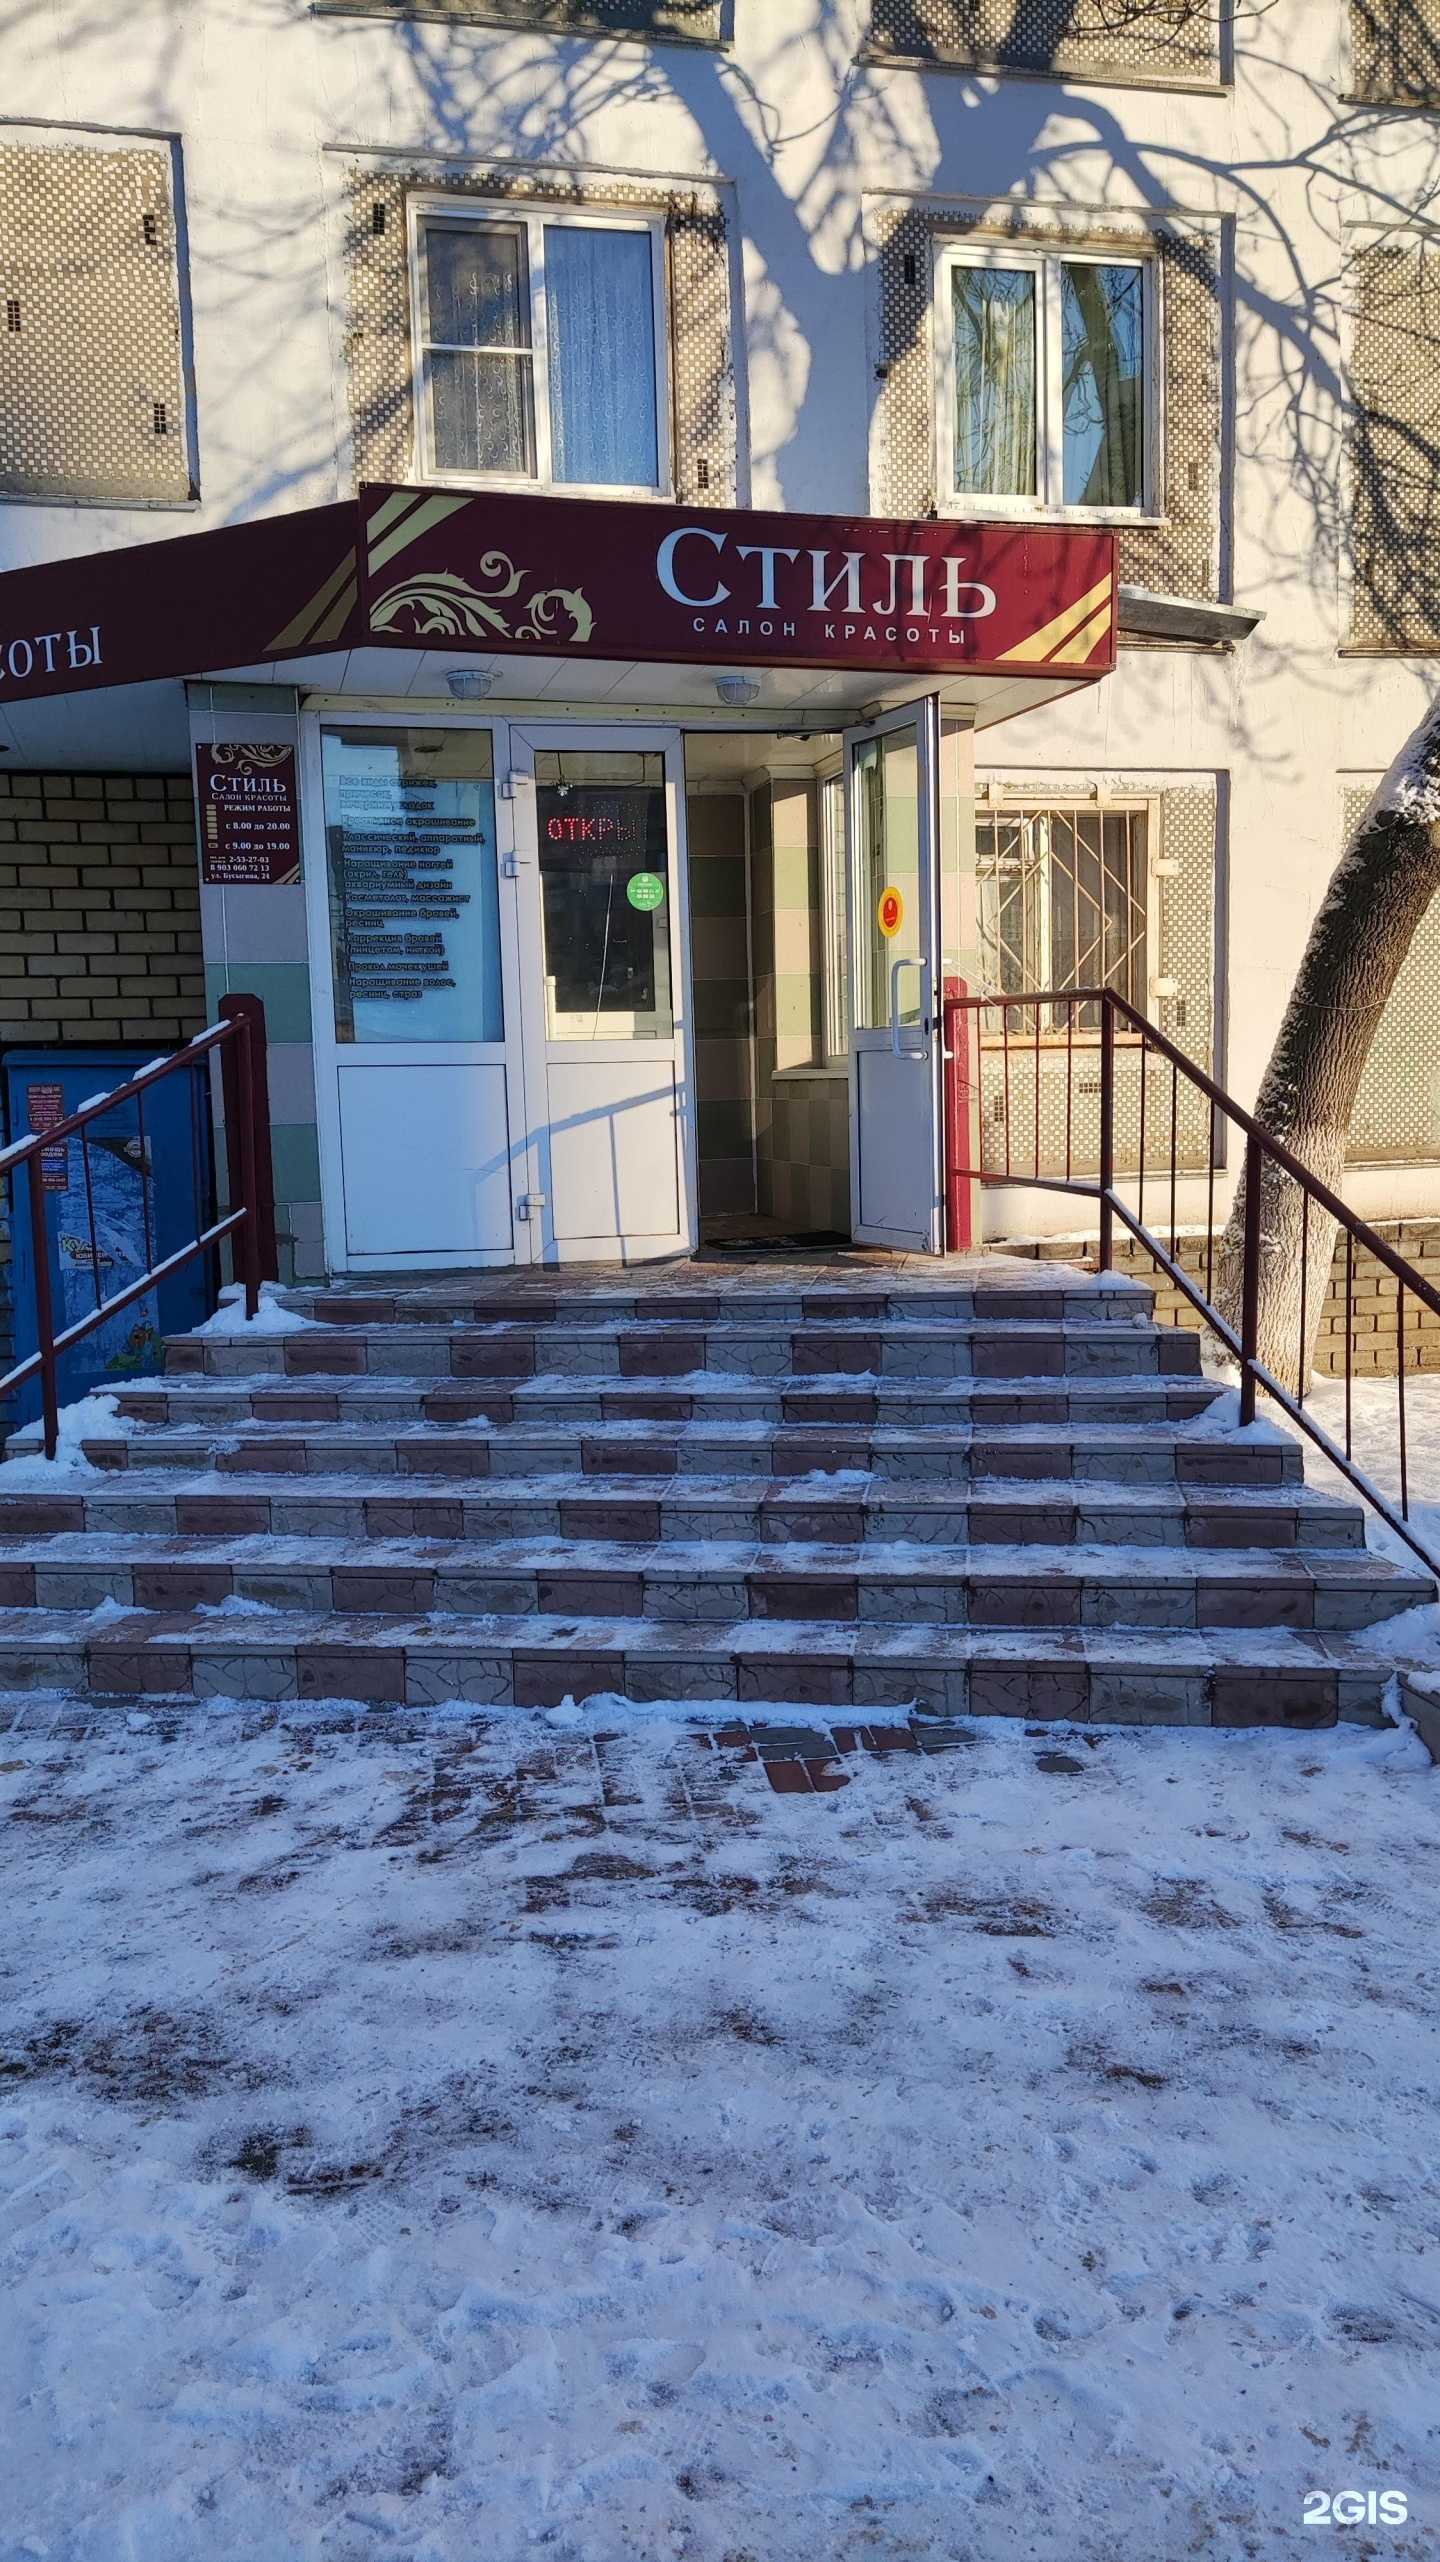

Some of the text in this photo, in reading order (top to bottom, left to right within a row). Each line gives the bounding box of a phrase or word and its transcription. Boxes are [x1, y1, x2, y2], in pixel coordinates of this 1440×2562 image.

[693, 617, 965, 644] САЛОН КРАСОТЫ
[0, 626, 103, 680] ОТЫ
[233, 822, 252, 830] 8.00
[266, 822, 290, 830] 20.00
[232, 842, 251, 850] 9.00
[266, 842, 290, 850] 19.00
